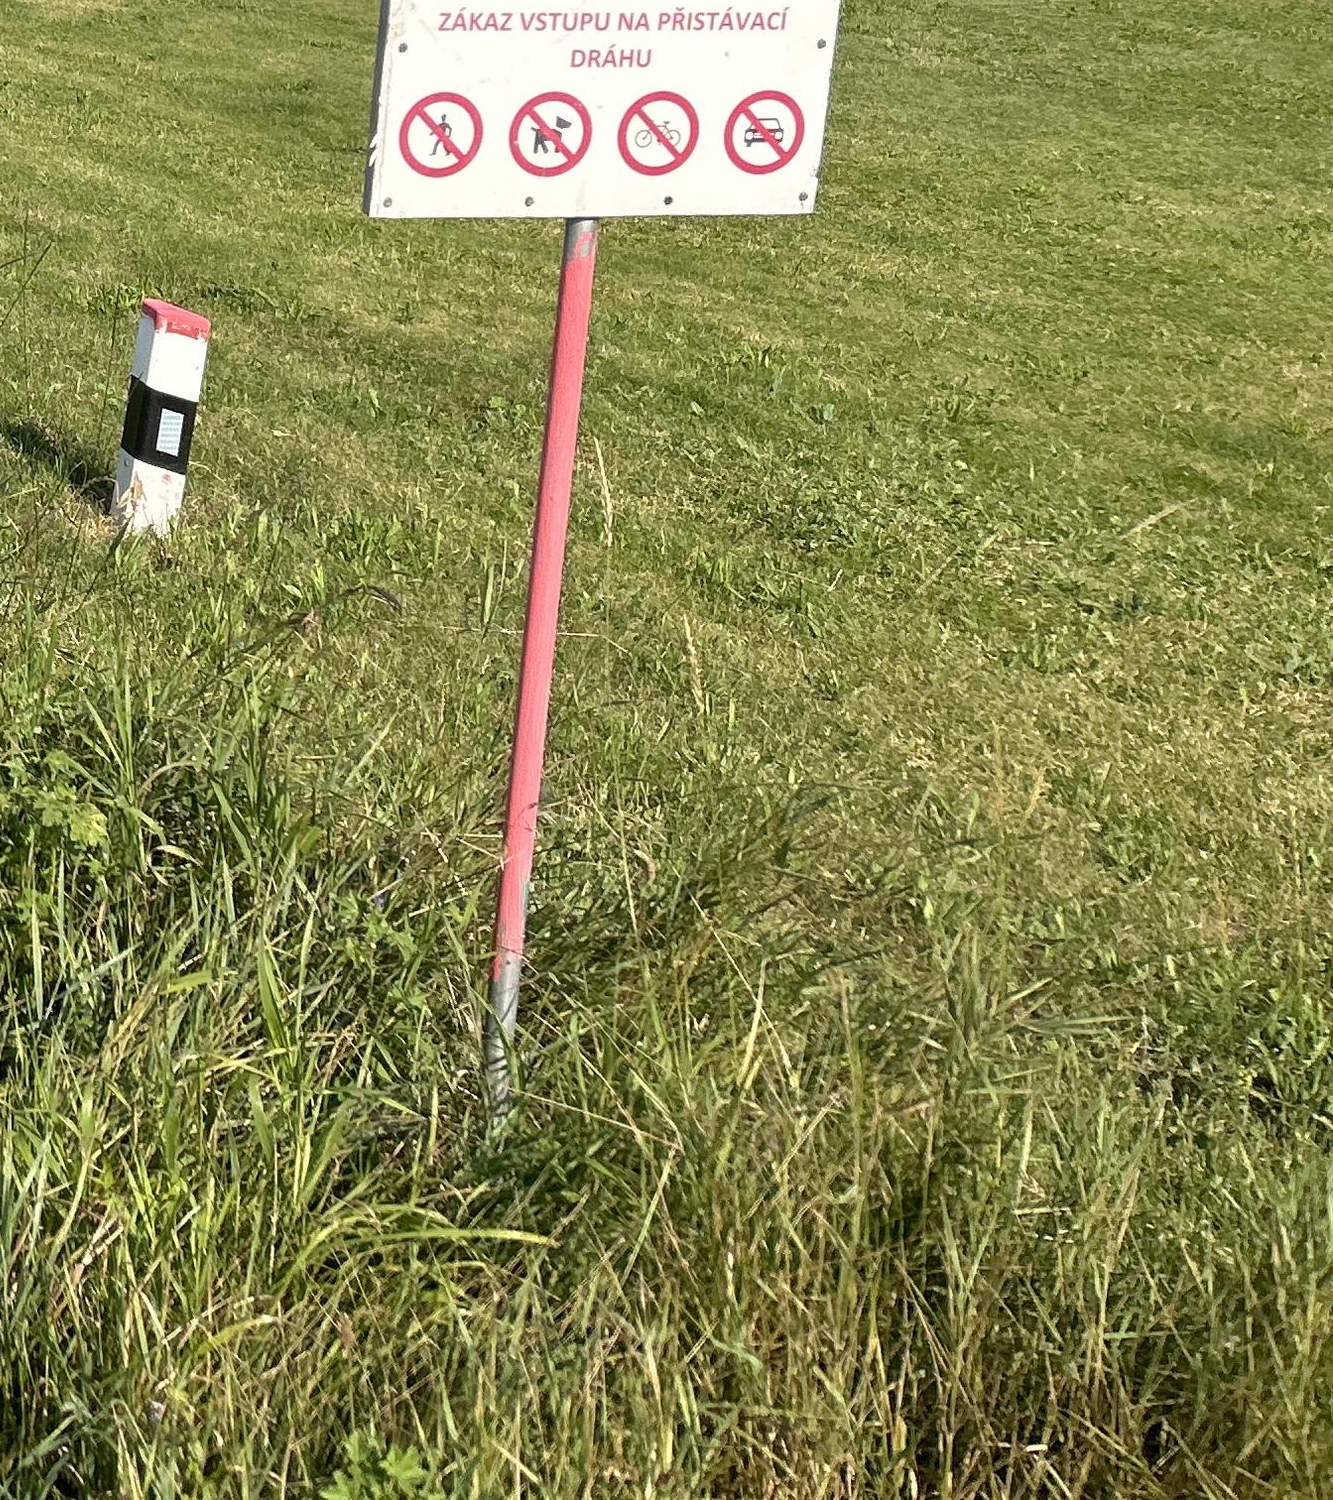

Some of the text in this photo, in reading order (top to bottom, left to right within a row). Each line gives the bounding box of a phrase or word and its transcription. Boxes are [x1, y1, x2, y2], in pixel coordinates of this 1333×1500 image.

[438, 6, 790, 32] ZÁKAZ VSTUPU NA PŘISTÁVACÍ
[570, 44, 652, 68] DRÁHU
